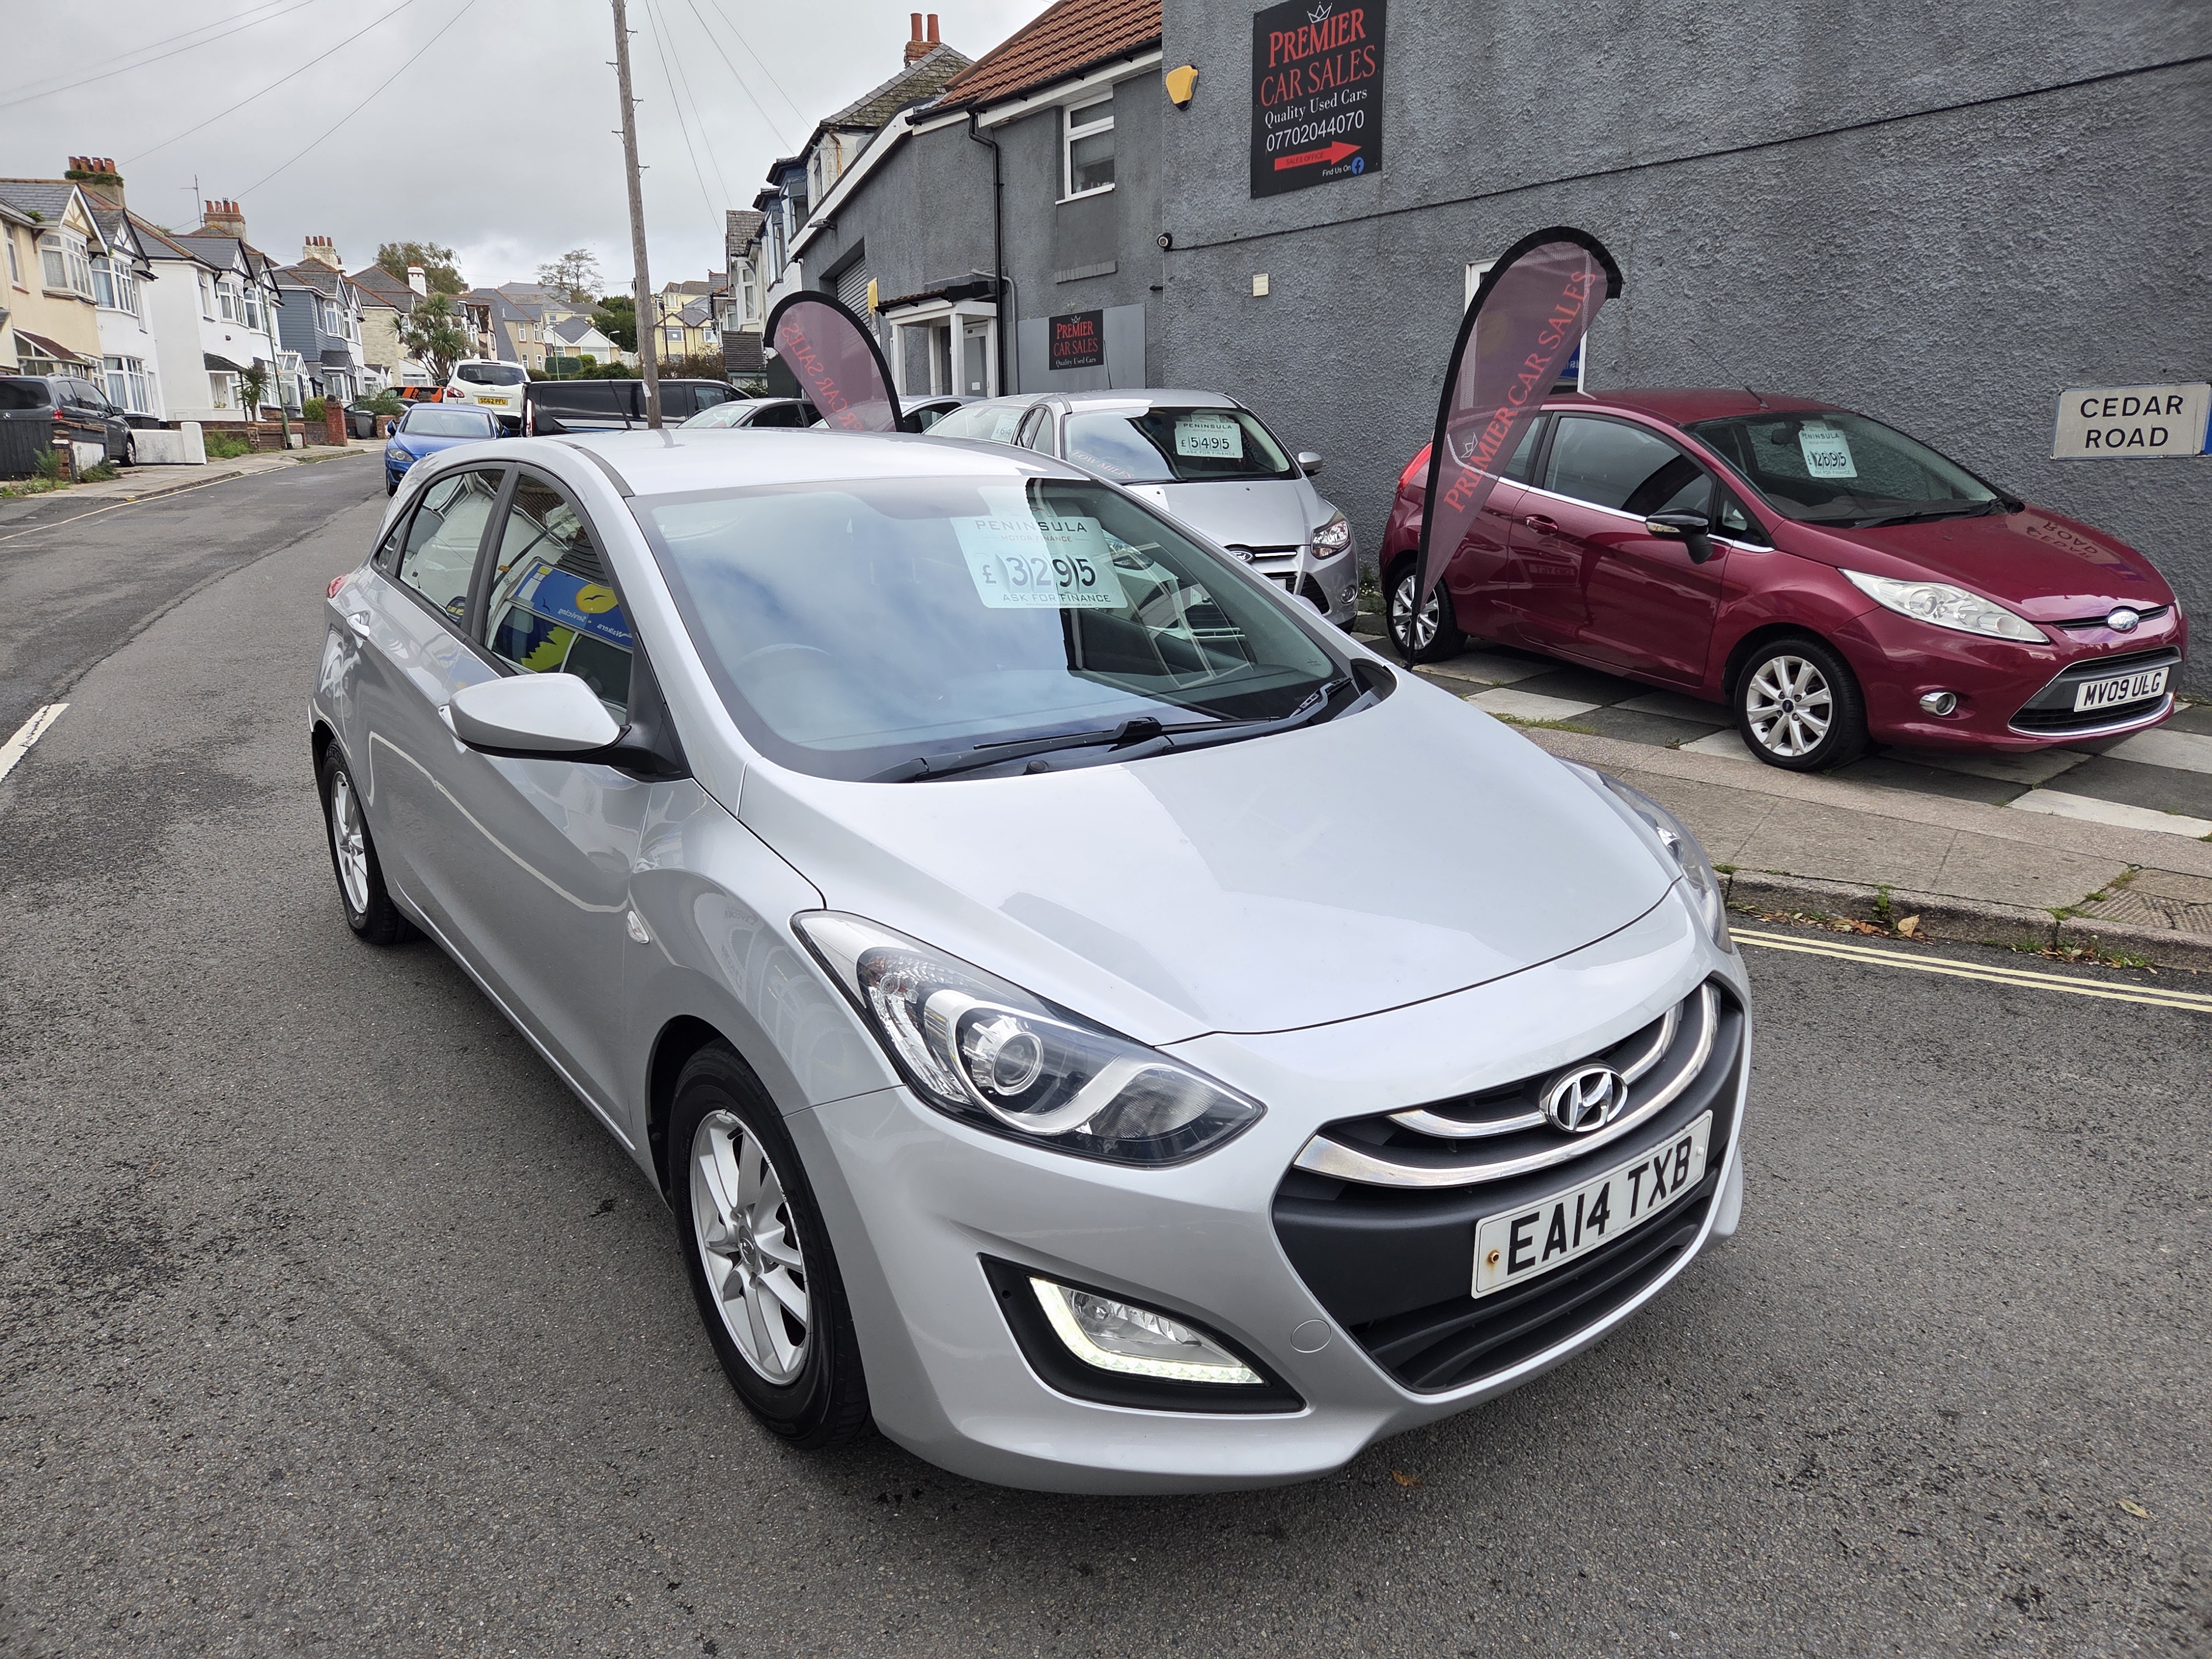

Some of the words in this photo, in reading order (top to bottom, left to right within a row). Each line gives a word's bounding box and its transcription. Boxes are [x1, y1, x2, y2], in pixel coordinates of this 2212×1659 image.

[1269, 8, 1366, 67] PREMIER
[1261, 69, 1303, 107] CAR
[1308, 45, 1376, 93] SALES
[1265, 106, 1306, 128] Quality
[1310, 93, 1337, 113] Used
[1341, 88, 1368, 105] Cars
[1266, 109, 1364, 152] 07702044070
[1286, 156, 1303, 165] SALES
[1304, 152, 1324, 161] OFFICE
[1322, 168, 1334, 177] Find
[1056, 321, 1094, 339] PREMIER
[1053, 342, 1071, 356] CAR
[1072, 338, 1098, 354] SALES
[1056, 359, 1072, 368] Quality
[1073, 357, 1084, 365] Used
[1443, 407, 1519, 513] PREMIER
[1508, 352, 1551, 406] CAR
[1538, 271, 1596, 349] SALES
[2080, 395, 2183, 418] CEDAR
[2085, 427, 2168, 448] ROAD
[1072, 451, 1099, 467] LOW
[974, 520, 1088, 533] PENINSULA
[2084, 679, 2130, 706] MV09
[2132, 672, 2162, 697] ULG
[1507, 1181, 1610, 1276] EA14
[1627, 1136, 1693, 1220] TXB
